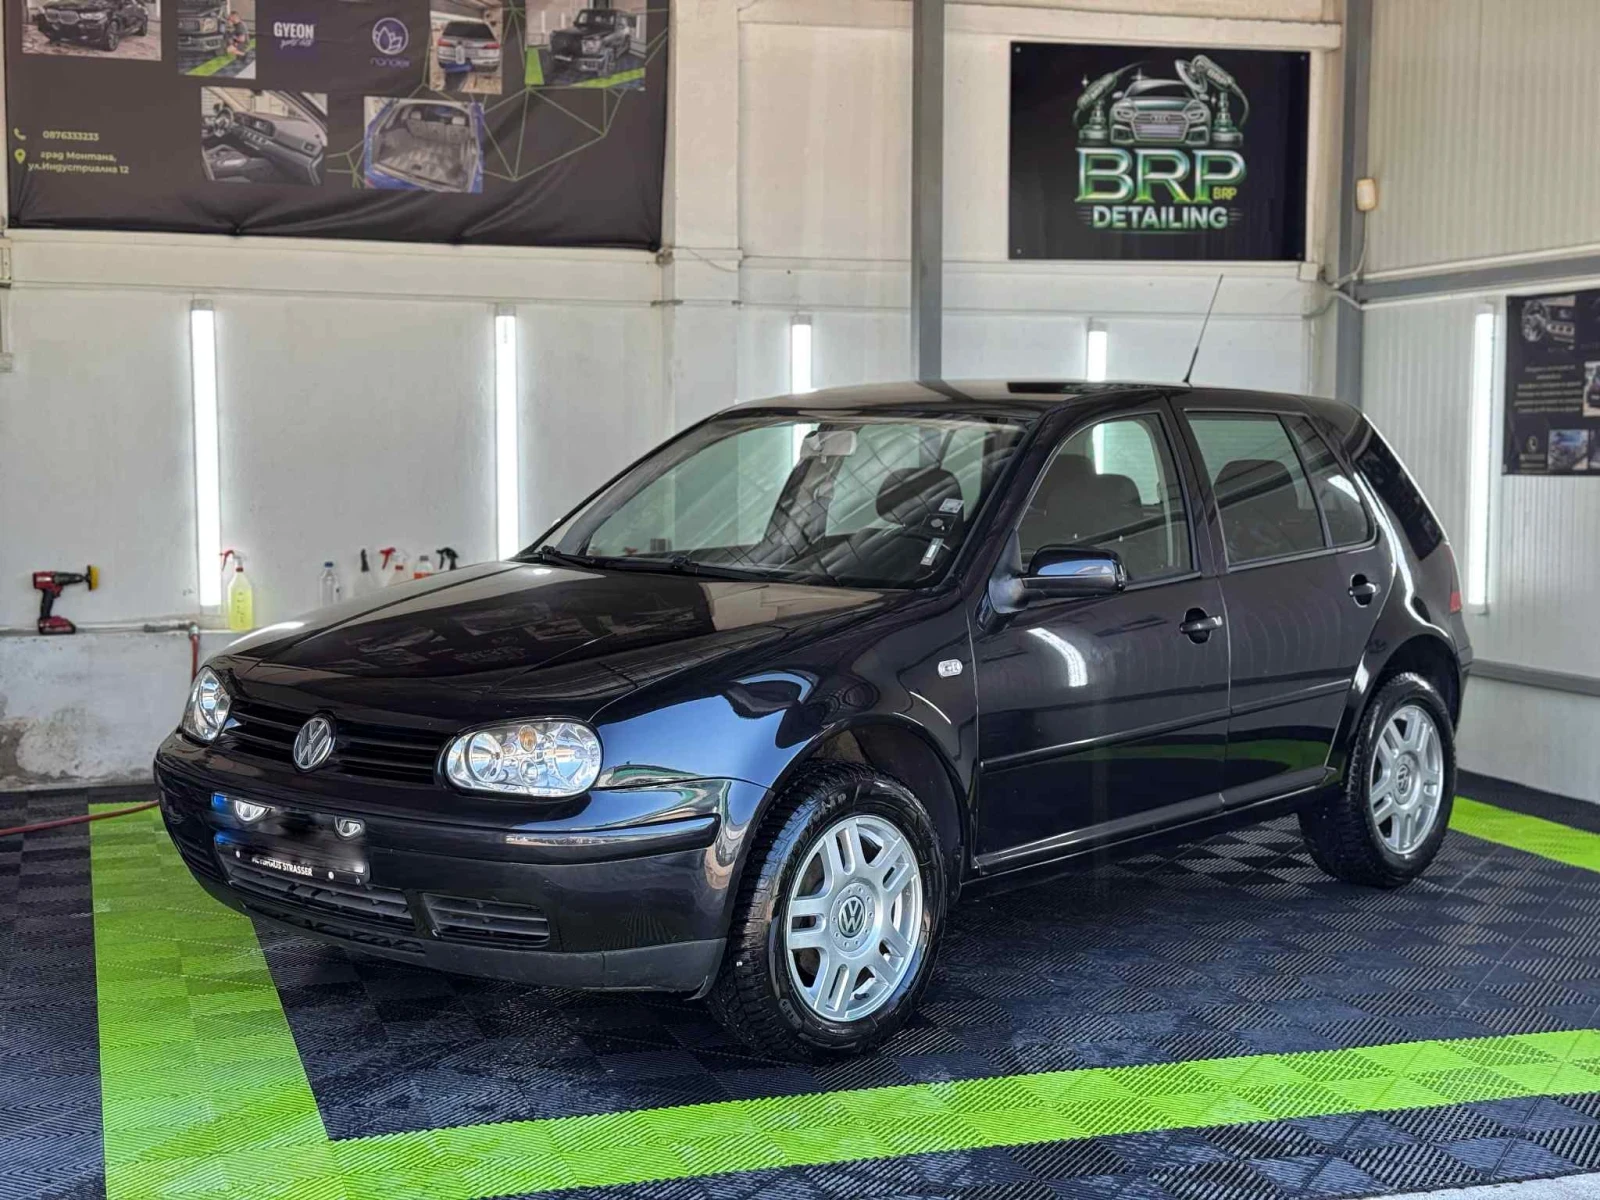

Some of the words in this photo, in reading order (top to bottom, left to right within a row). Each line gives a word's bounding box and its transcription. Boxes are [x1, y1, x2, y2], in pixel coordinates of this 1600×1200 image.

[273, 21, 315, 39] GYEON
[1075, 147, 1247, 203] BRP
[1212, 186, 1237, 200] BRP
[1092, 205, 1228, 228] DETAILING
[282, 862, 314, 877] STRASSER
